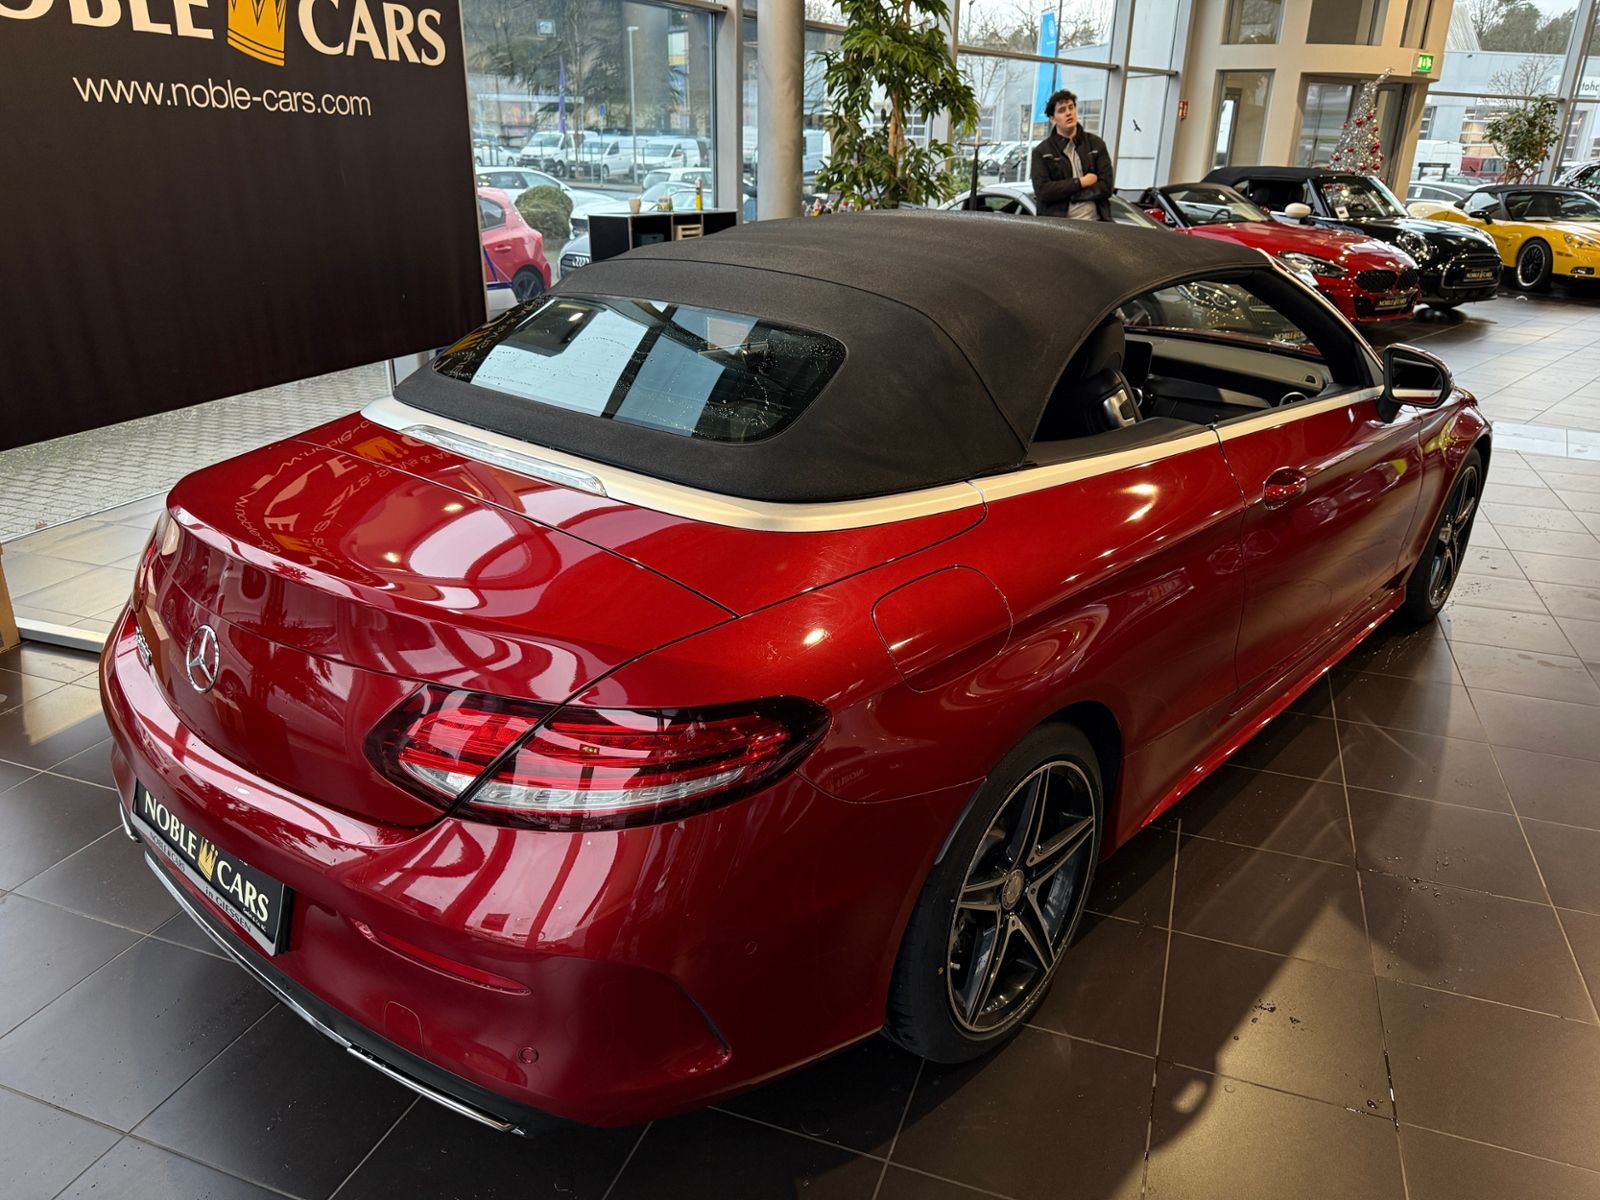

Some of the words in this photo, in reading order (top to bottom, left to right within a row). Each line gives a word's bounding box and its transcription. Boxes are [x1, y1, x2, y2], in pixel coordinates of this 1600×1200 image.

[297, 0, 447, 67] CARS
[72, 76, 373, 117] www.noble-cars.com
[144, 790, 197, 860] NOBLE
[217, 860, 270, 922] CARS
[215, 895, 252, 932] GIESSEN
